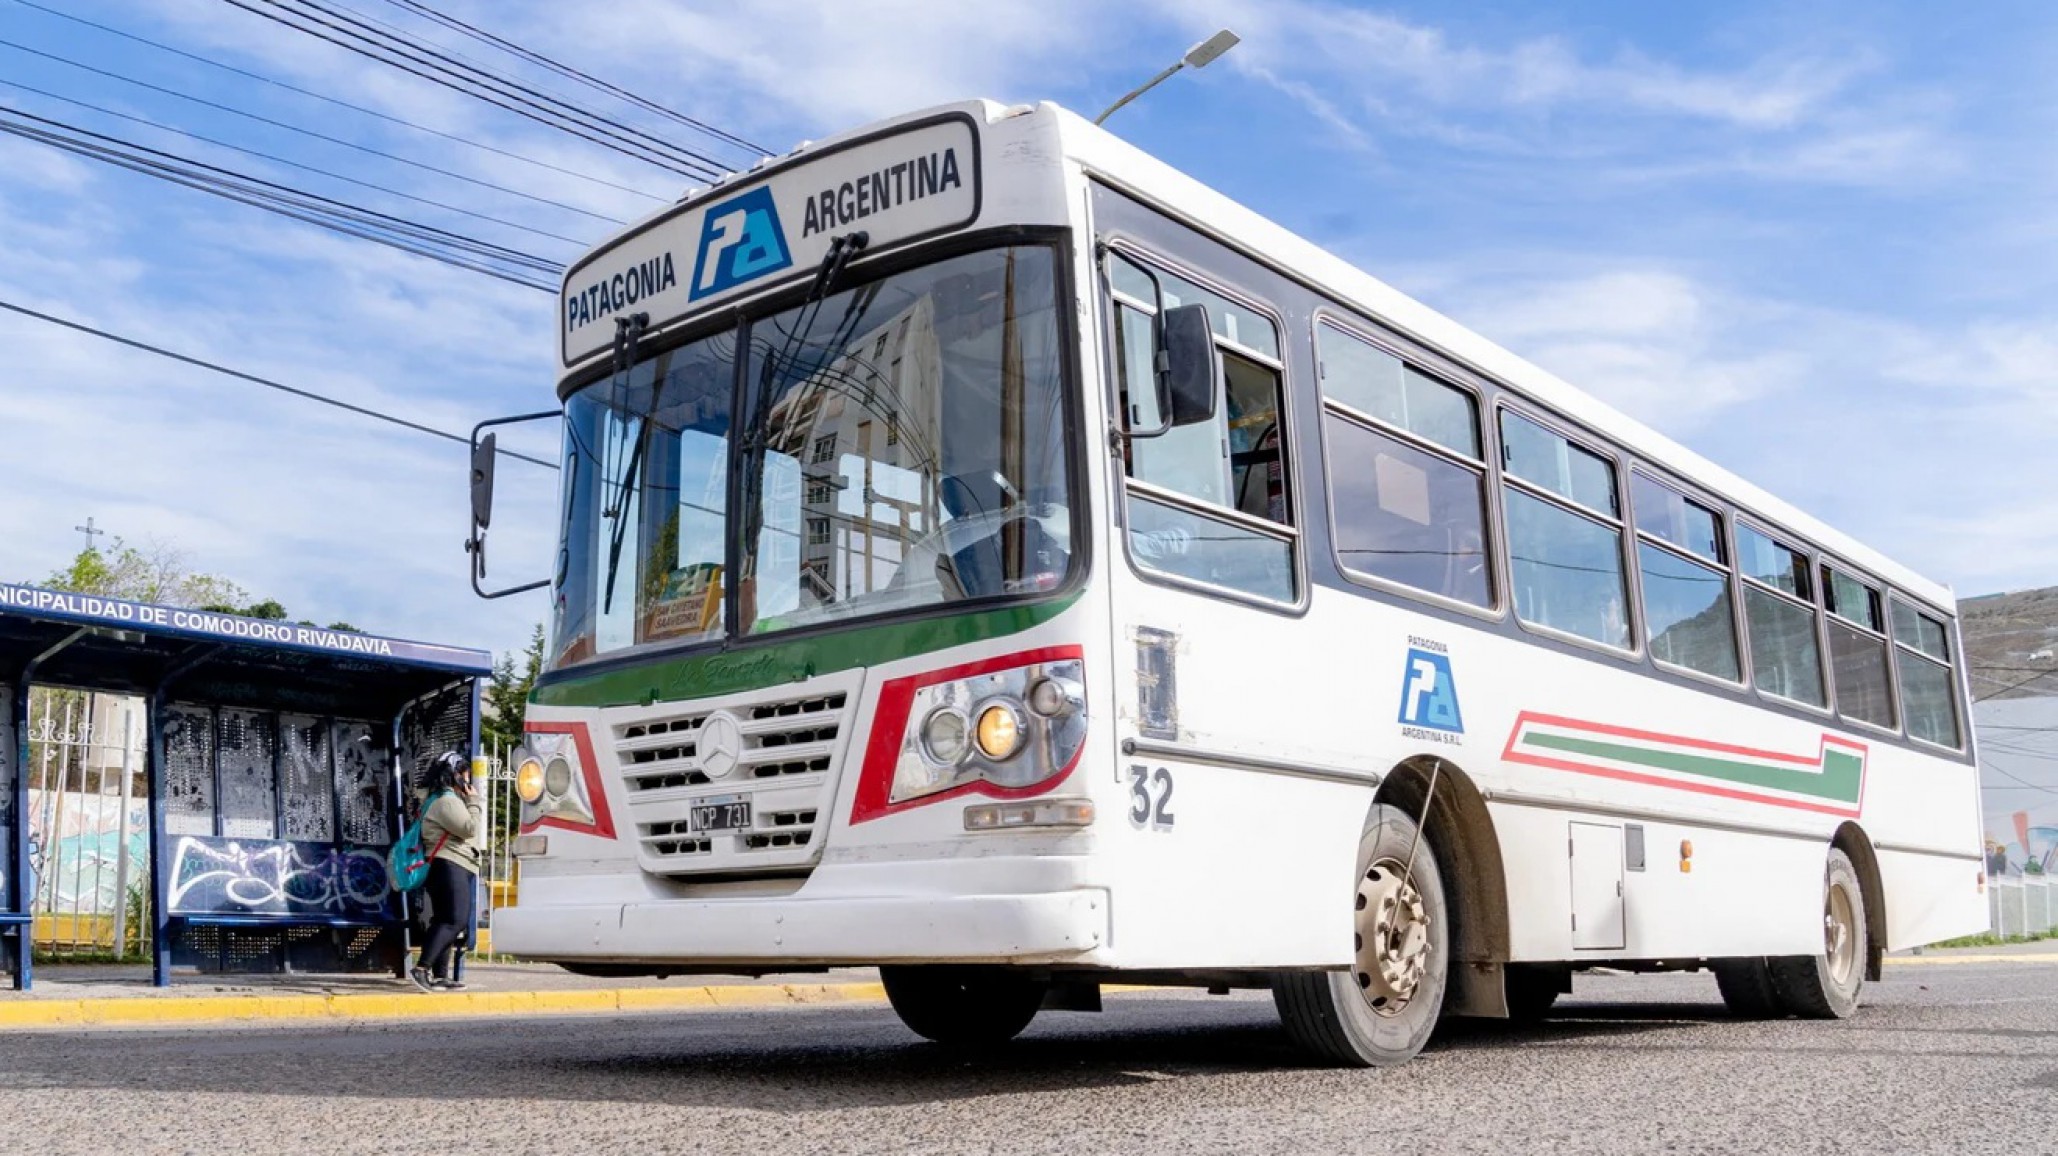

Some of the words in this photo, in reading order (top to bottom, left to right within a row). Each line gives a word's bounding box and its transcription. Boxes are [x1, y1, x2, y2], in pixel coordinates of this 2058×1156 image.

[568, 252, 677, 332] PATAGONIA
[802, 147, 961, 239] ARGENTINA
[139, 607, 168, 626] DE
[174, 611, 292, 643] COMODORO
[297, 629, 393, 656] RIVADAVIA
[654, 612, 698, 630] SAAVEDRA
[1408, 634, 1448, 653] PATAGONIA
[1402, 727, 1443, 743] ARGENTINA
[1443, 733, 1463, 746] S.R.L.
[1130, 764, 1175, 828] 32
[691, 807, 717, 830] NCP
[724, 803, 750, 828] 731
